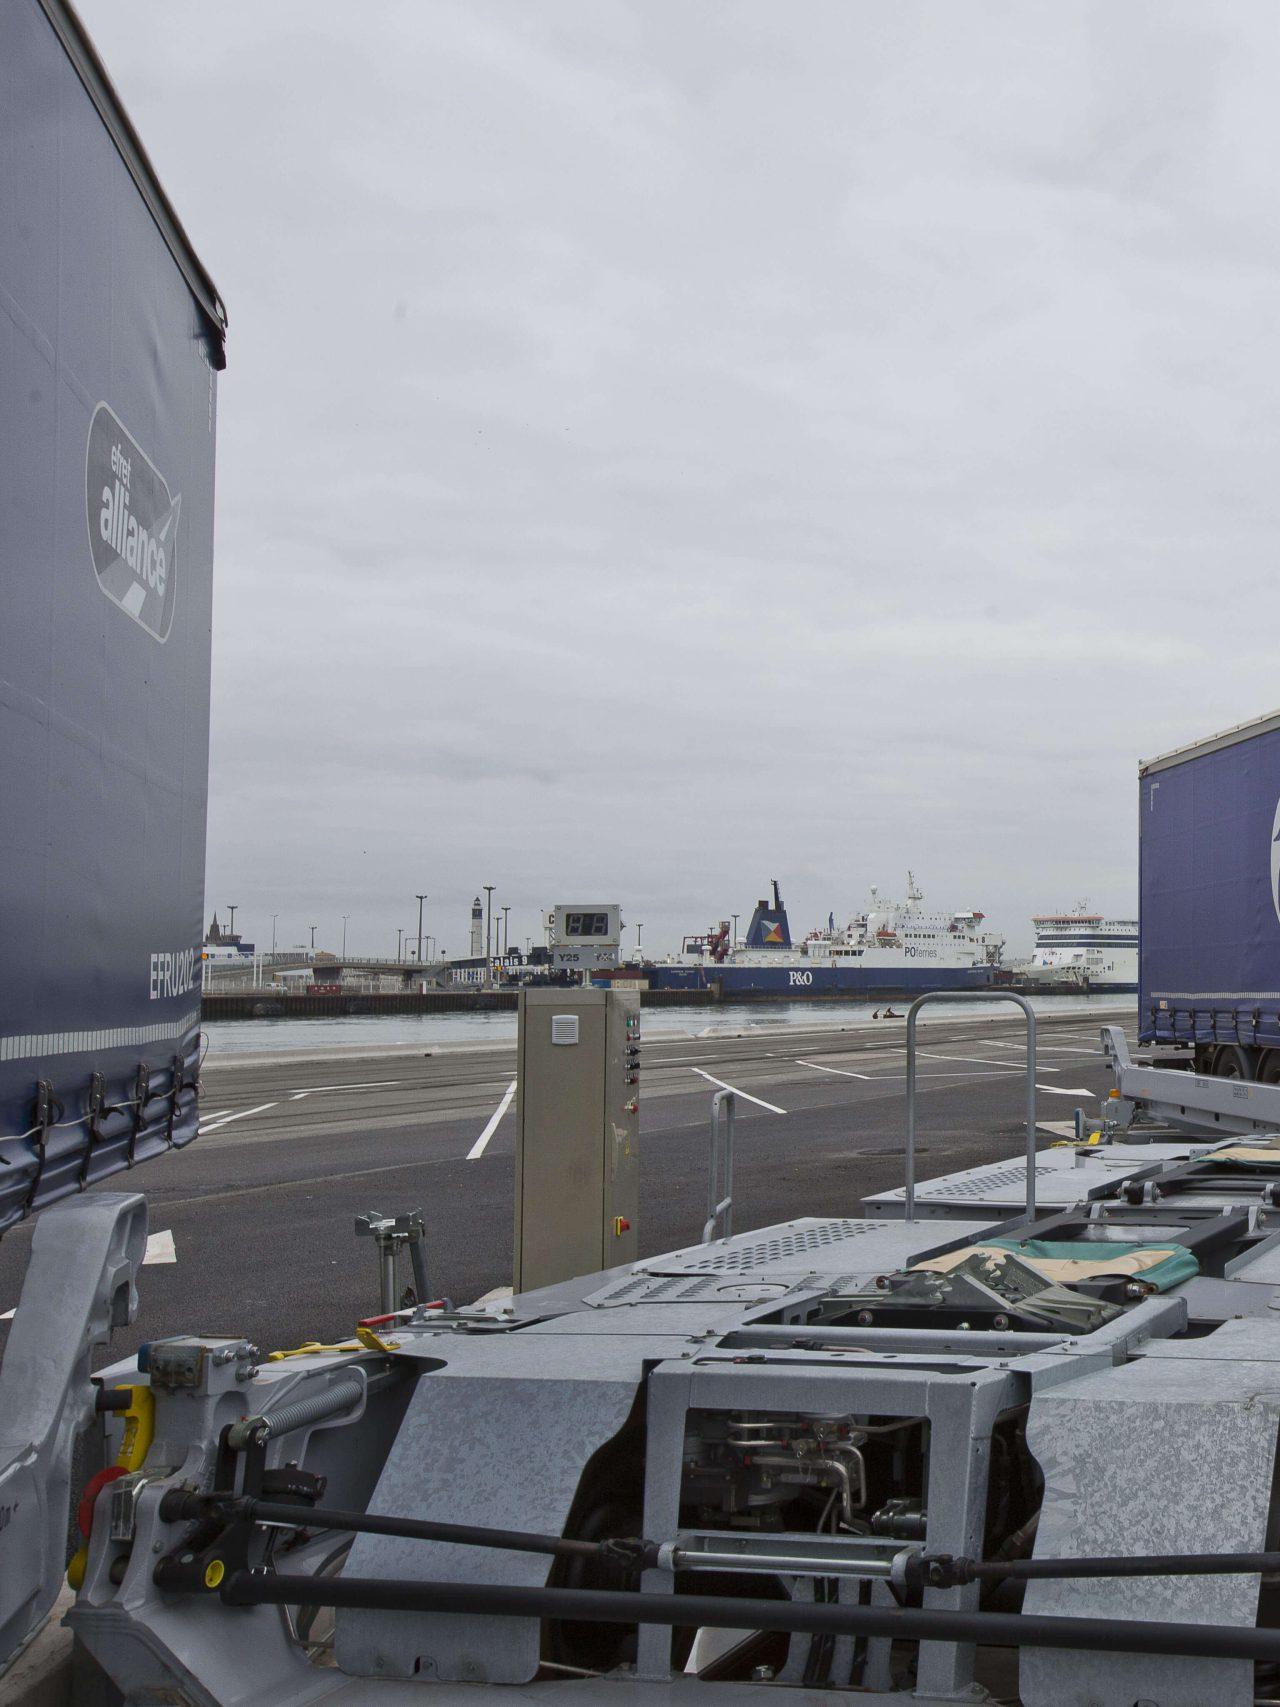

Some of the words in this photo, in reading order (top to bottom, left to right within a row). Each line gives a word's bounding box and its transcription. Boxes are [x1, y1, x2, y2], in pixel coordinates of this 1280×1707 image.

[111, 443, 131, 490] efret
[100, 479, 166, 597] alliance
[150, 947, 194, 1000] EFRU202
[489, 956, 519, 967] Calais
[521, 955, 528, 966] 9
[558, 953, 580, 963] Y25
[788, 971, 813, 986] P&O
